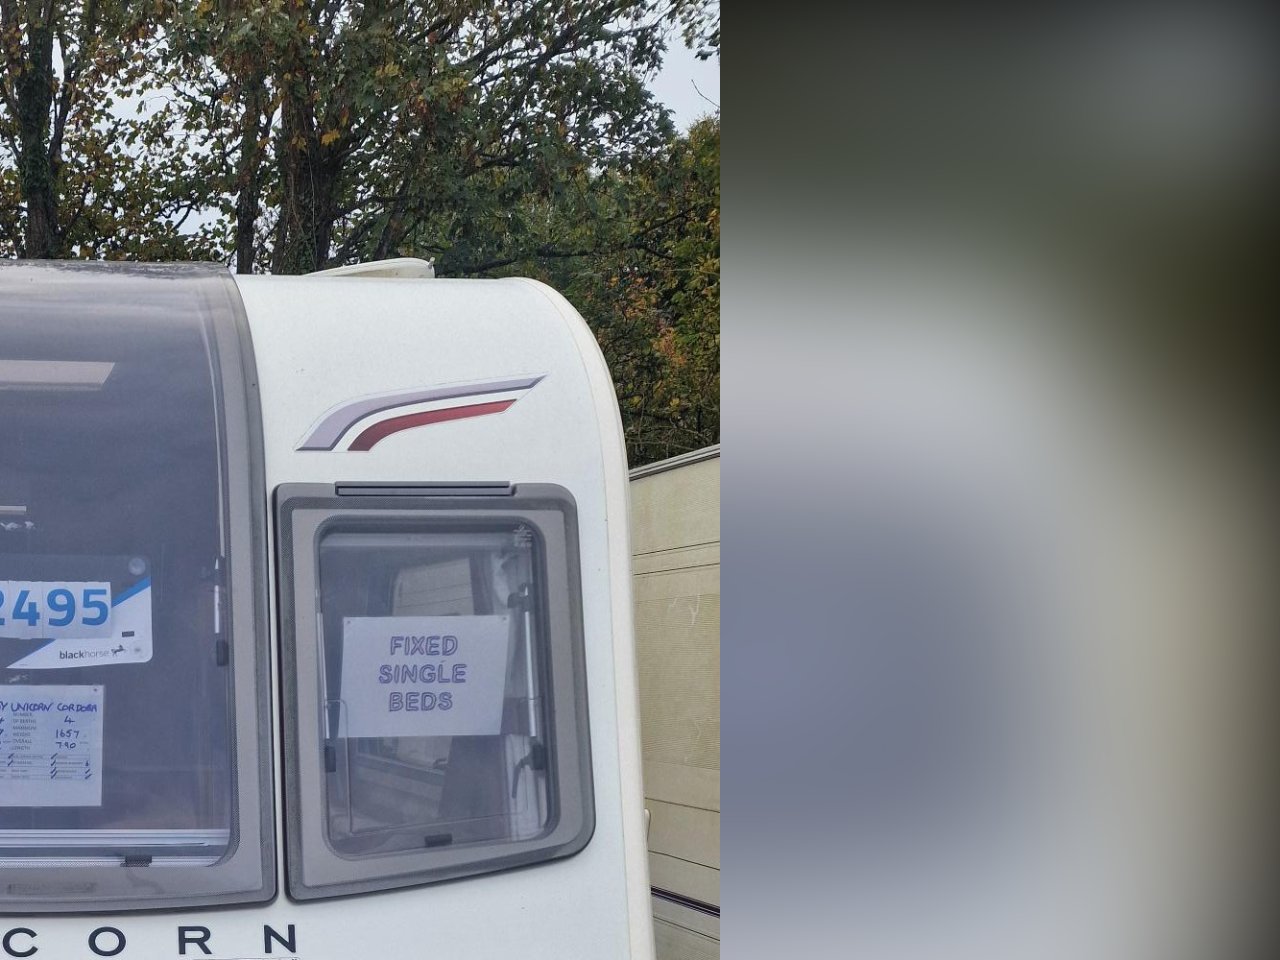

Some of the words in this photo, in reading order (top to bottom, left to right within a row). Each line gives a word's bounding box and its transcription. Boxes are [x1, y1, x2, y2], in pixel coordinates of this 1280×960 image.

[390, 635, 458, 656] FIXED
[378, 663, 468, 684] SINGLE
[10, 701, 54, 713] UNICORN
[389, 691, 454, 712] BEDS
[63, 714, 76, 725] 4
[55, 728, 80, 739] 1657
